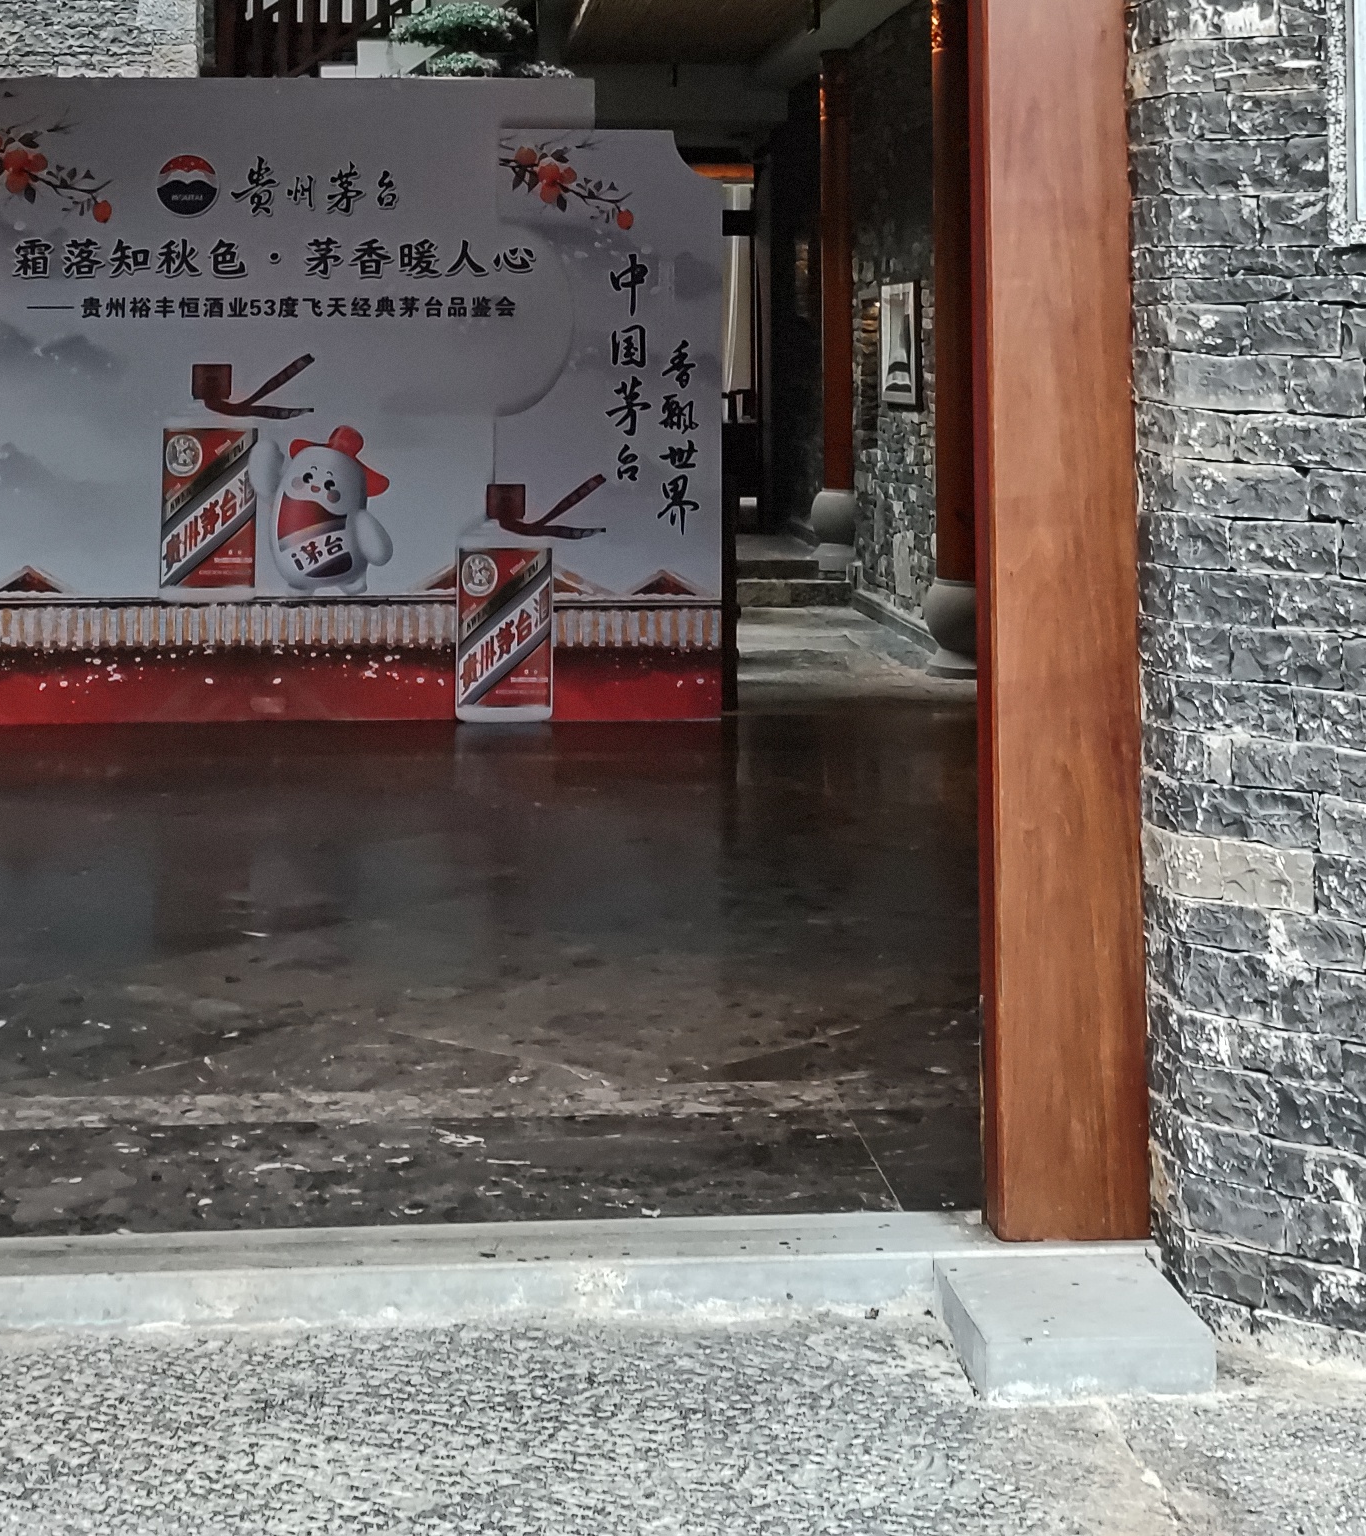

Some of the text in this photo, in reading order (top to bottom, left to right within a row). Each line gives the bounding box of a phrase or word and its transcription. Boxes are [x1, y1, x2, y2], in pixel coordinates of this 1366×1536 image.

[230, 156, 401, 217] 贵州茅台
[605, 253, 652, 482] 中国茅台
[657, 339, 700, 536] 香飘世界
[291, 534, 344, 572] i茅台
